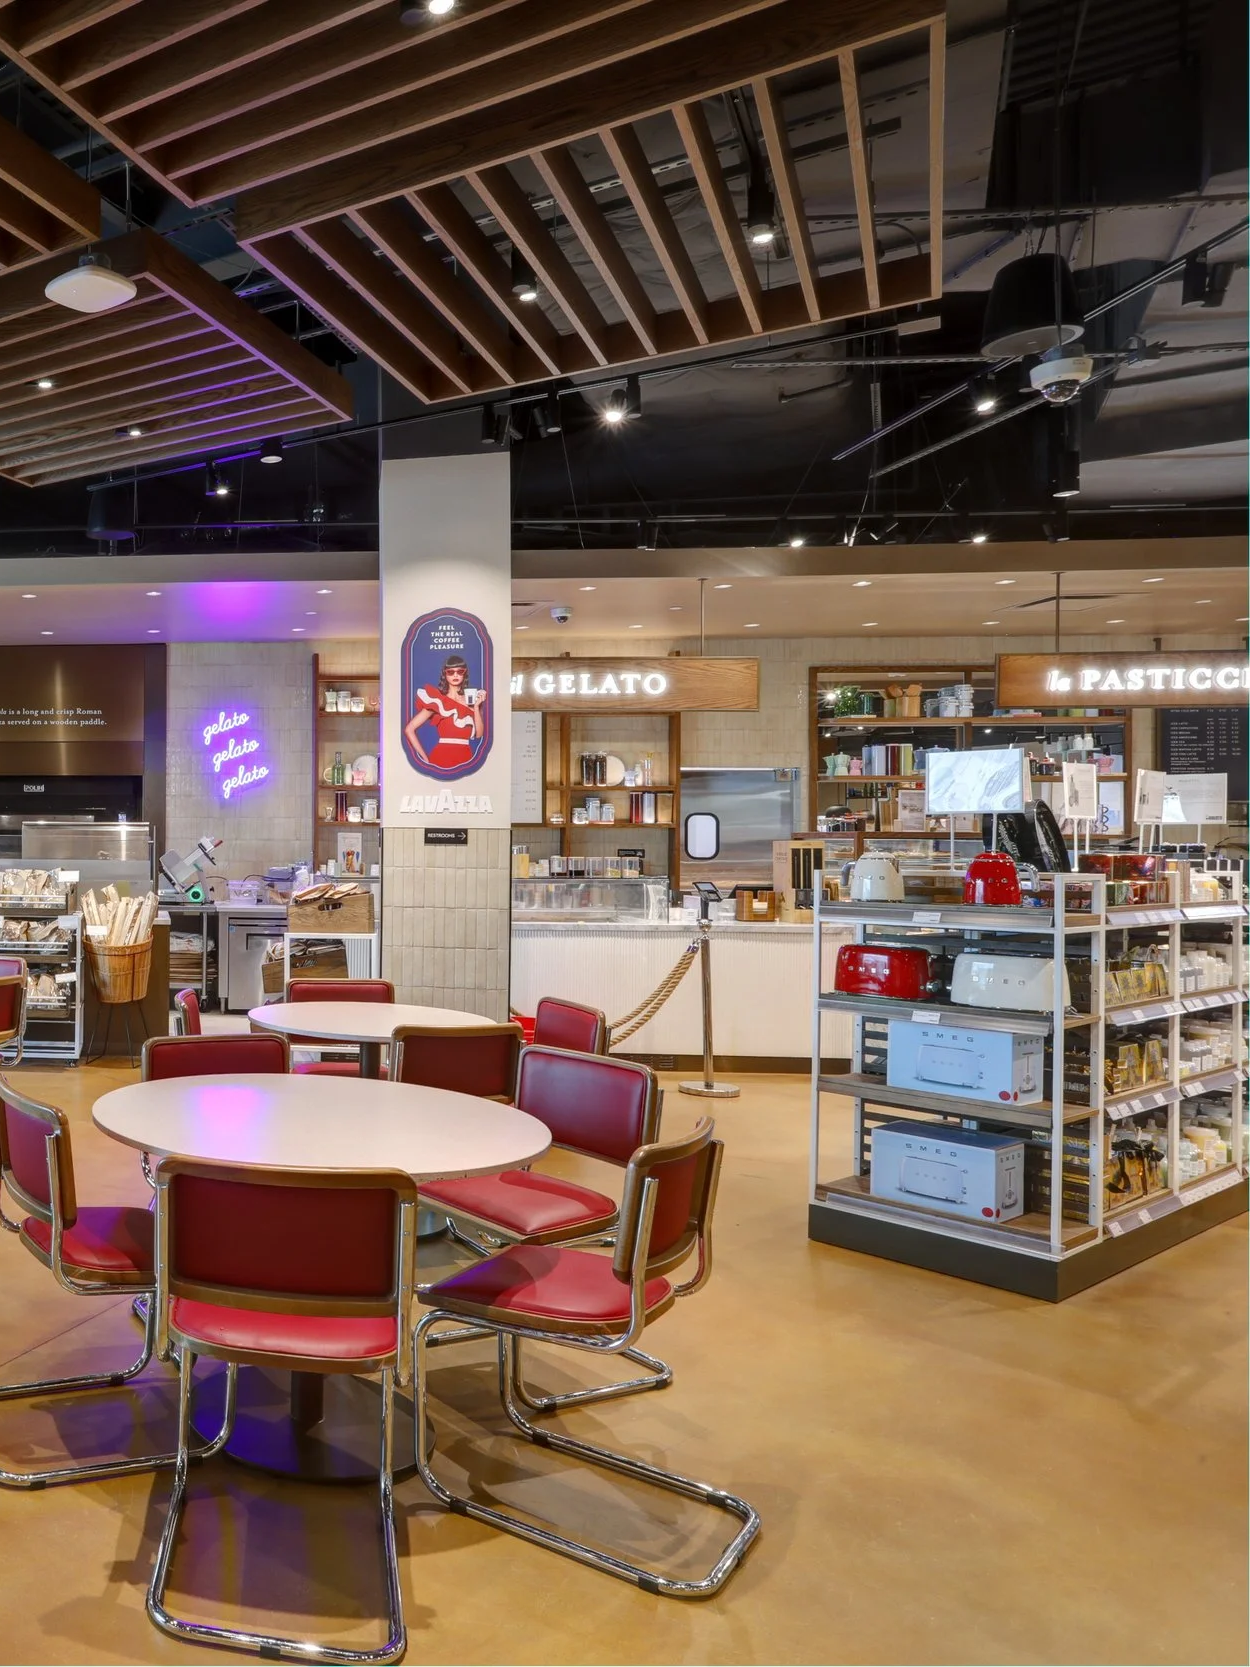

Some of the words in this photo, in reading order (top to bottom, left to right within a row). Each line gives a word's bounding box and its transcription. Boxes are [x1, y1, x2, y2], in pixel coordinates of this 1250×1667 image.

[534, 673, 667, 695] GELATO
[1048, 669, 1071, 691] la
[22, 708, 39, 717] long
[56, 708, 74, 717] crisp
[203, 711, 250, 745] gelato
[212, 738, 260, 772] gelato
[222, 765, 269, 799] gelato
[399, 789, 494, 814] LAVAZZA
[922, 1031, 974, 1043] SMEG
[905, 1143, 957, 1158] SMEG
